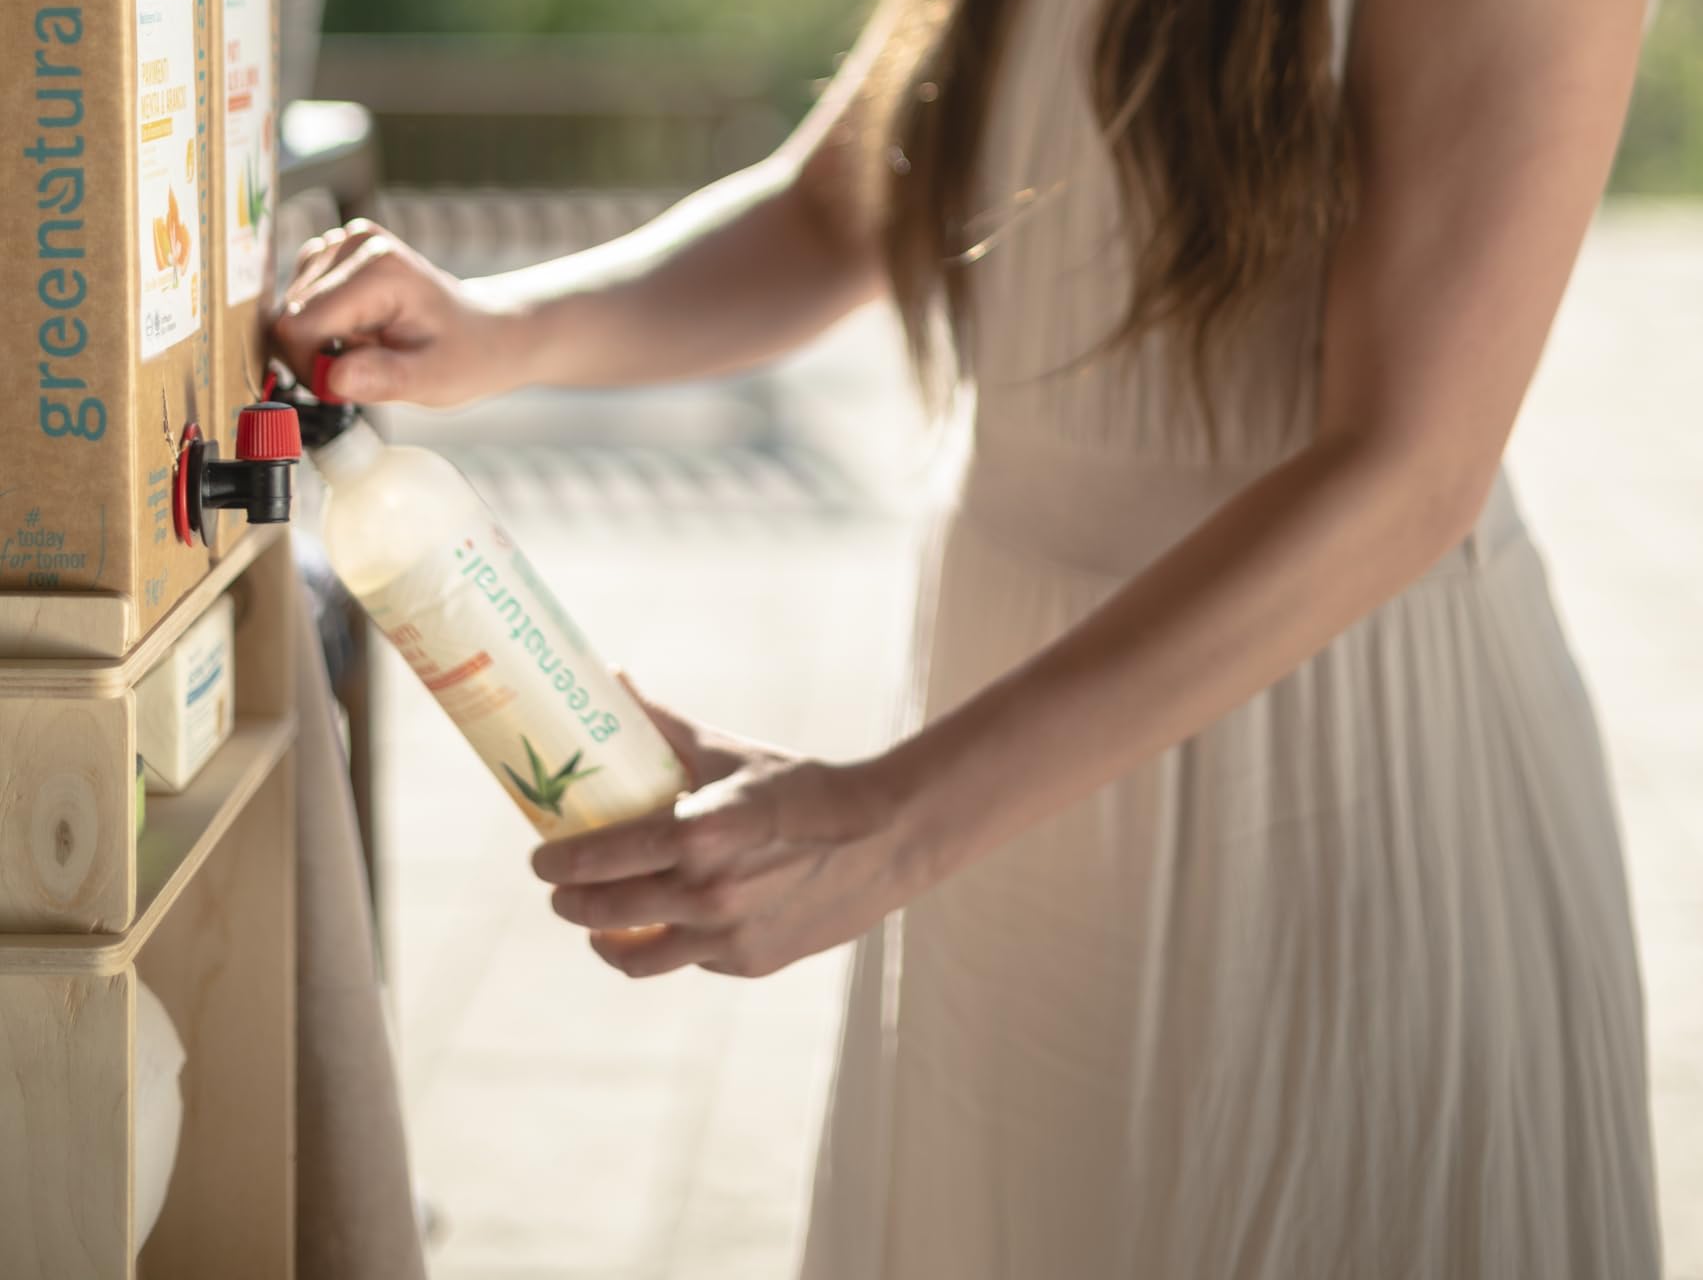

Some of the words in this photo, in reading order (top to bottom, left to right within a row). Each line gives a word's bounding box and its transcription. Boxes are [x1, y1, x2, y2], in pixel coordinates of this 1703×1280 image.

[16, 528, 65, 550] today
[35, 550, 87, 569] tomor
[460, 552, 621, 744] greenatural
